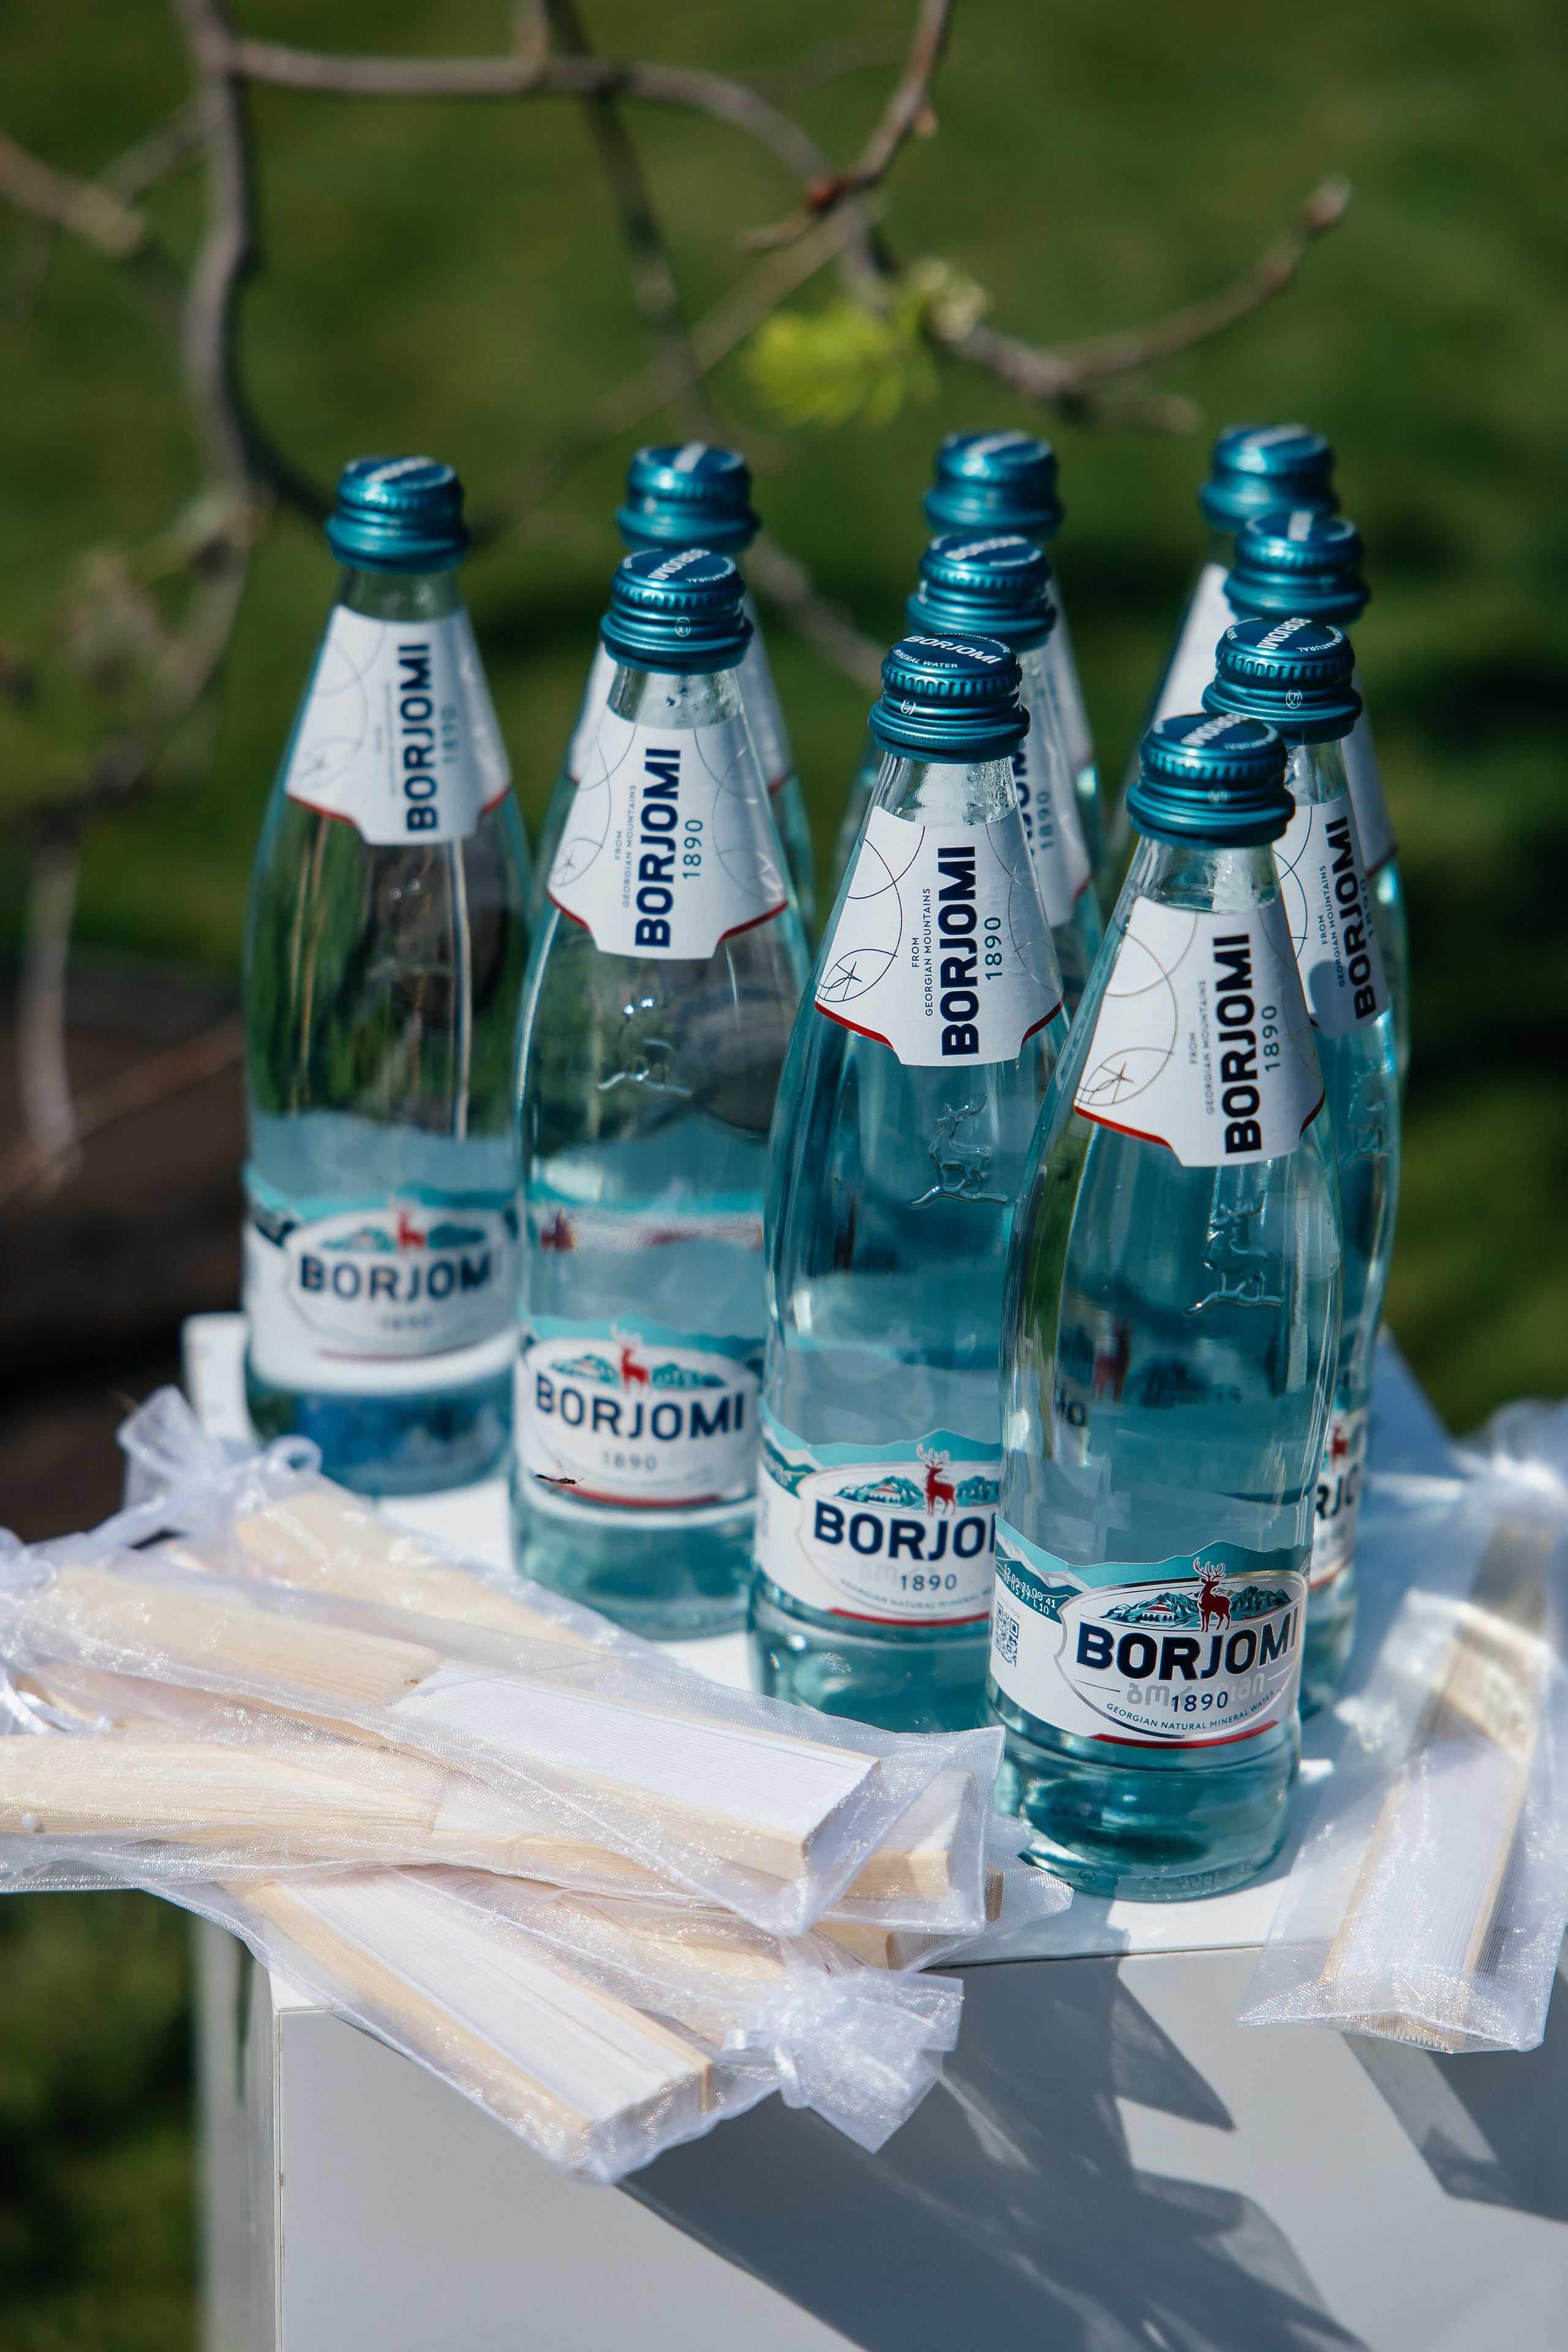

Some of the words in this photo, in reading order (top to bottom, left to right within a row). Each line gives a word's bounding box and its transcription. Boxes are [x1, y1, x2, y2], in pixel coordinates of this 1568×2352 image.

[893, 649, 919, 664] MINERAL
[902, 636, 1002, 665] BORJOMI
[1256, 617, 1312, 650] BORJOMI
[398, 643, 437, 832] BORJOMI
[622, 846, 630, 908] GEORGIAN
[626, 785, 636, 843] MOUNTAINS
[634, 747, 682, 948] BORJOMI
[682, 819, 704, 880] 1890
[923, 887, 932, 949] MOUNTAINS
[1319, 864, 1335, 933] MOUNTAINS
[1324, 816, 1376, 1021] BORJOMI
[911, 936, 920, 968] FROM
[937, 845, 981, 1057] BORJOMI
[984, 916, 1003, 981] 1890
[1330, 939, 1346, 989] GEORGIAN
[1198, 979, 1210, 1047] MOUNTAINS
[1212, 932, 1263, 1156] BORJOMI
[1264, 1005, 1282, 1072] 1890
[1189, 1031, 1198, 1065] FROM
[1205, 1050, 1216, 1115] GEORGIAN
[536, 1370, 745, 1441] BORJOMI
[813, 1499, 996, 1561] BORJO
[891, 1598, 935, 1609] NATURAL
[900, 1573, 957, 1591] 1890
[1046, 1597, 1056, 1609] 41
[1076, 1604, 1298, 1681] BORJOMI
[1107, 1703, 1158, 1727] GEORGIAN
[1161, 1722, 1207, 1730] NATURAL
[1210, 1710, 1248, 1728] MINERAL
[1250, 1690, 1274, 1711] WATER
[1171, 1691, 1229, 1713] 1890
